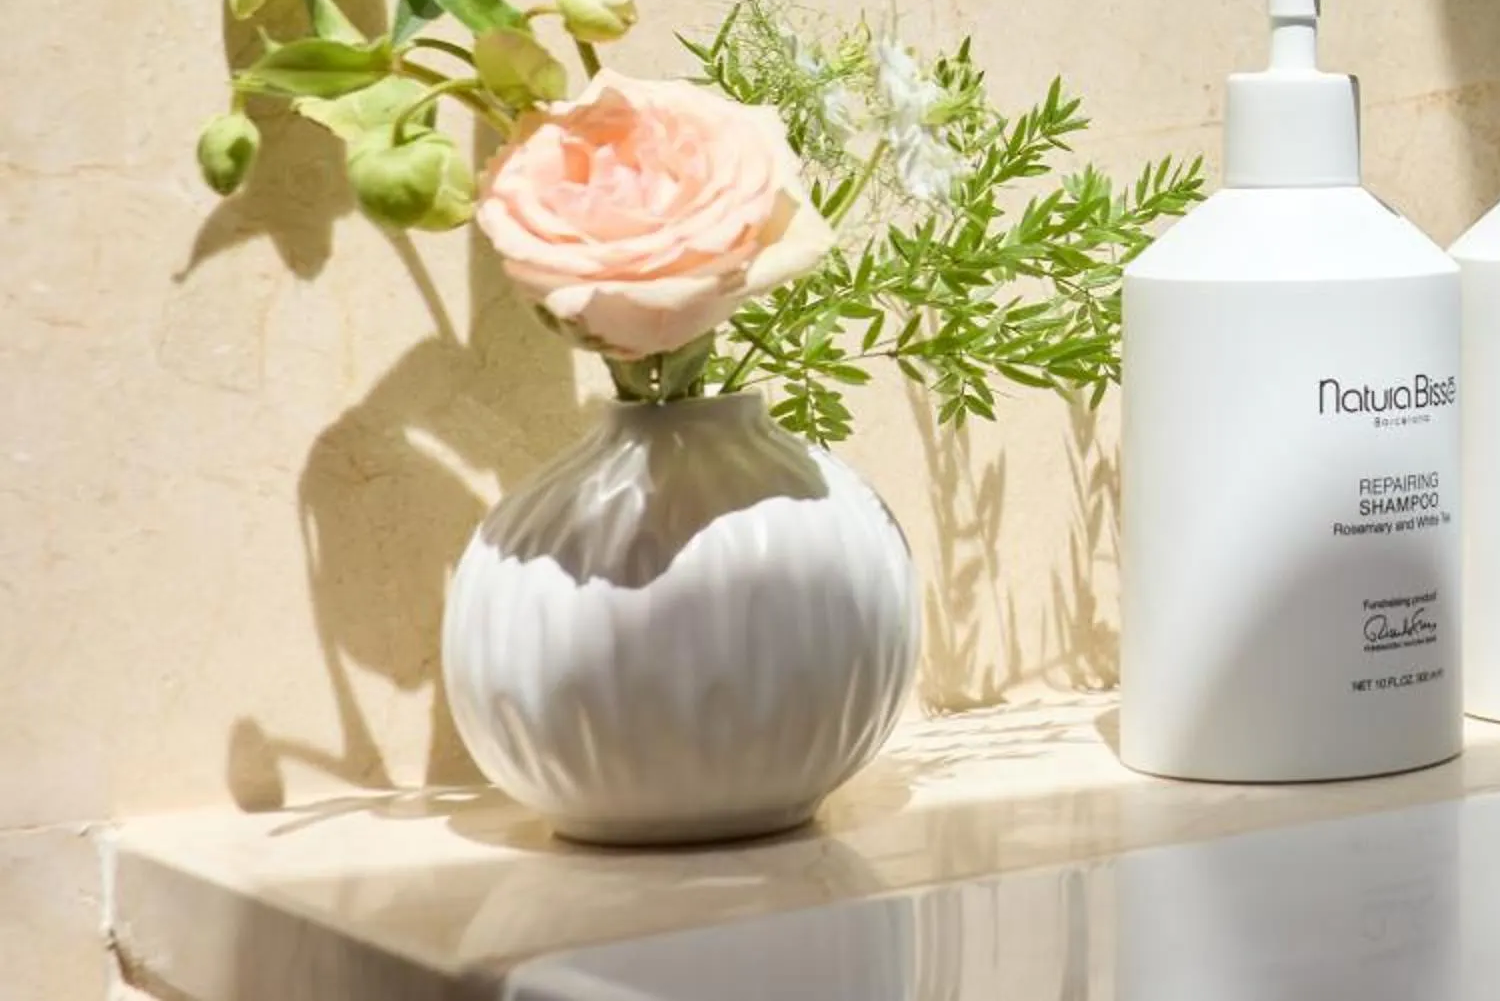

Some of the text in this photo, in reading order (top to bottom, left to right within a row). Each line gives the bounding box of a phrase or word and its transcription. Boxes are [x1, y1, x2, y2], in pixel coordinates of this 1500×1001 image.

[1359, 471, 1439, 496] REPAIRING
[1359, 492, 1439, 516] SHAMPOO
[1396, 518, 1415, 531] and
